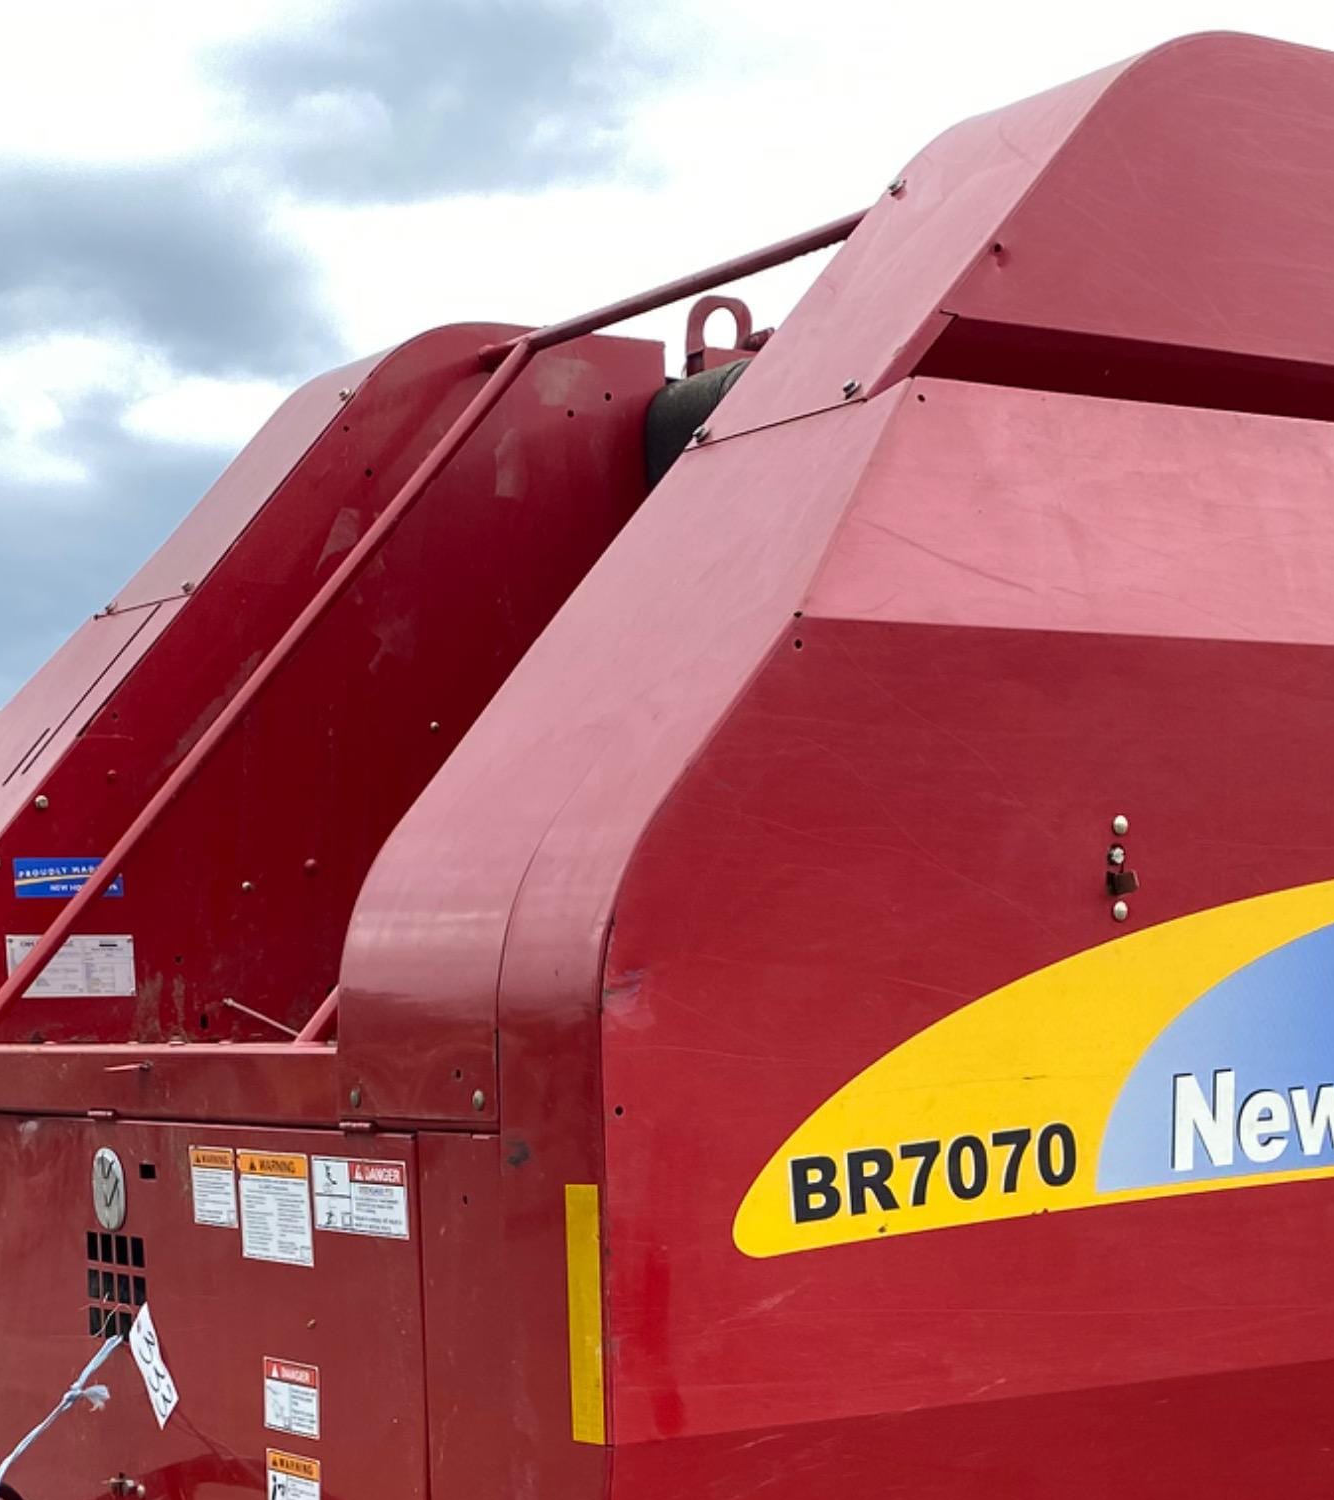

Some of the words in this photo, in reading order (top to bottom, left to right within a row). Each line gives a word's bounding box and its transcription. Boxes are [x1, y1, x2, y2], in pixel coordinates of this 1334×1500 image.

[18, 865, 67, 878] PROUDLY
[72, 863, 99, 874] MAD
[259, 1158, 296, 1174] WARNING
[790, 1122, 1077, 1224] BR7070
